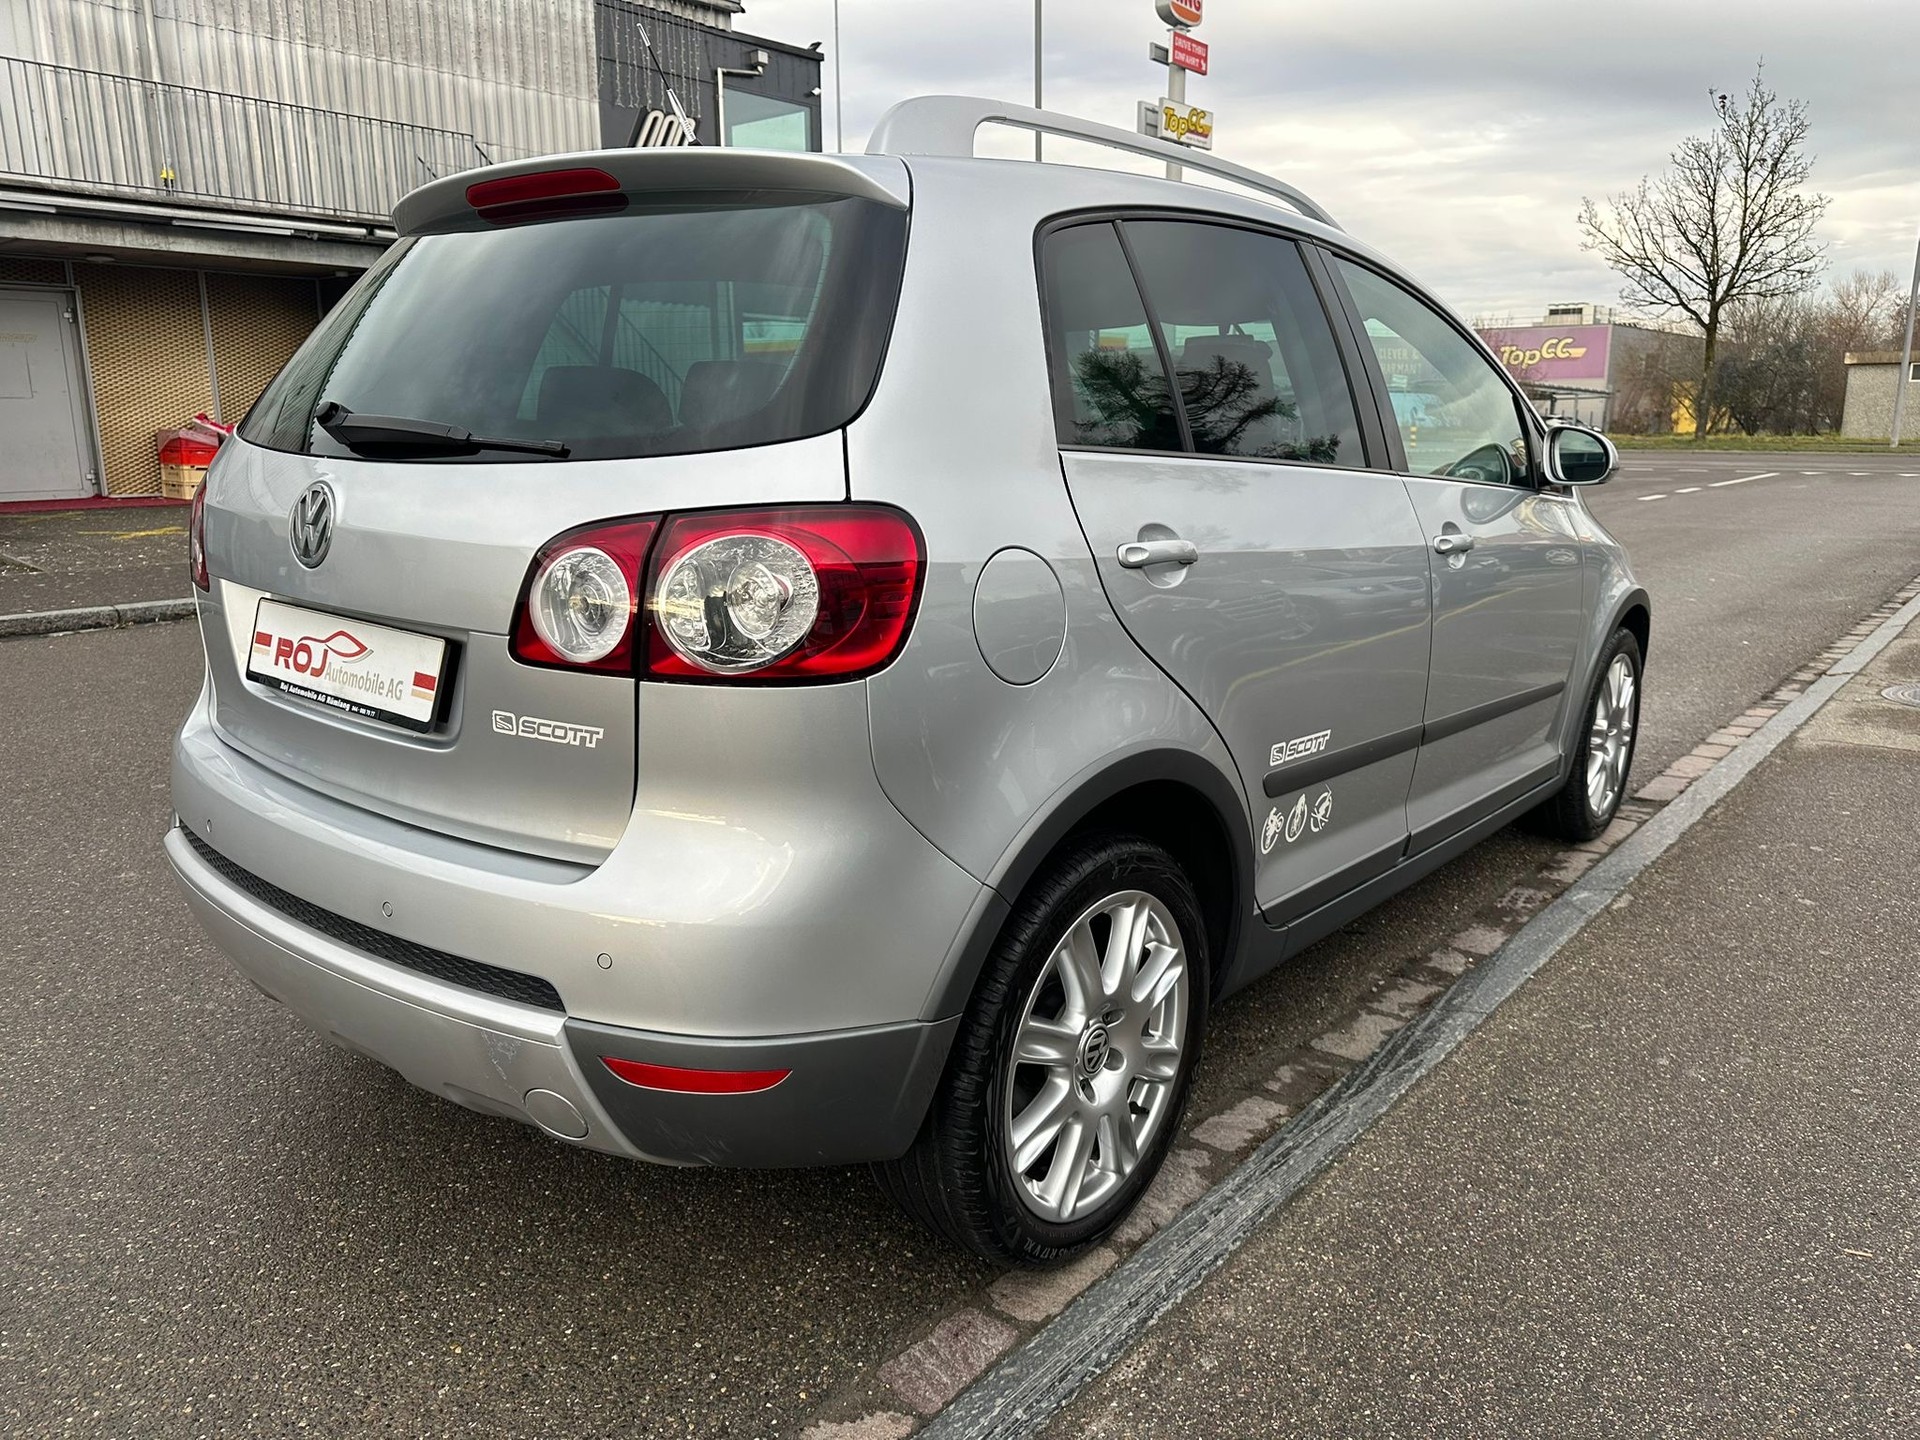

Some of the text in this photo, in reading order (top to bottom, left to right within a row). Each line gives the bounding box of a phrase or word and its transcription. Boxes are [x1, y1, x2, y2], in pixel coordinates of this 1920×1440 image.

[274, 636, 329, 678] ROJ
[324, 662, 404, 700] Automobile AG
[317, 692, 327, 704] AG
[518, 716, 604, 748] SCOTT
[1285, 729, 1332, 762] SCOTT
